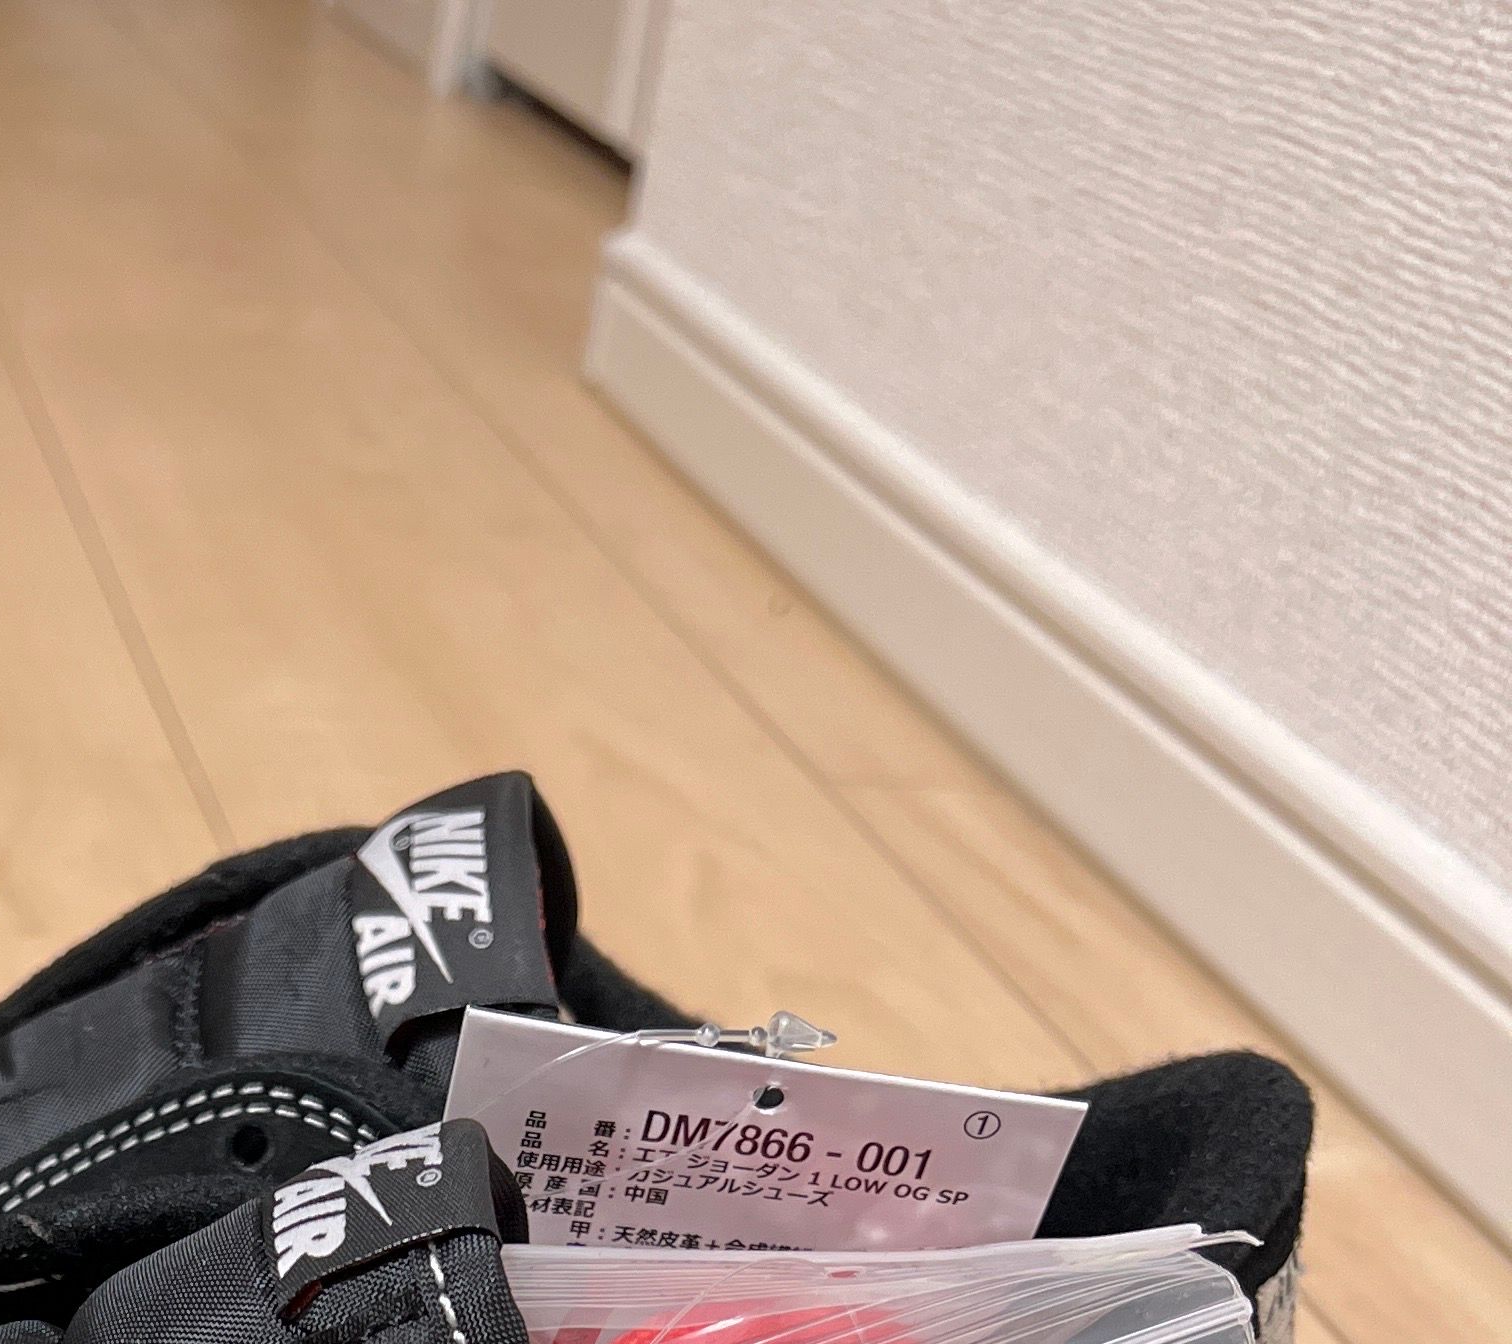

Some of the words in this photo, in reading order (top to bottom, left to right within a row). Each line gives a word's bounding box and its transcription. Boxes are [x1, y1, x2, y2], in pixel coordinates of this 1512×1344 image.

[408, 810, 493, 924] NIKE
[352, 914, 417, 1019] AIR
[830, 1174, 888, 1194] LOW
[894, 1183, 930, 1201] OG
[936, 1189, 969, 1206] SP
[856, 1142, 933, 1180] 001
[273, 1176, 346, 1279] AIR
